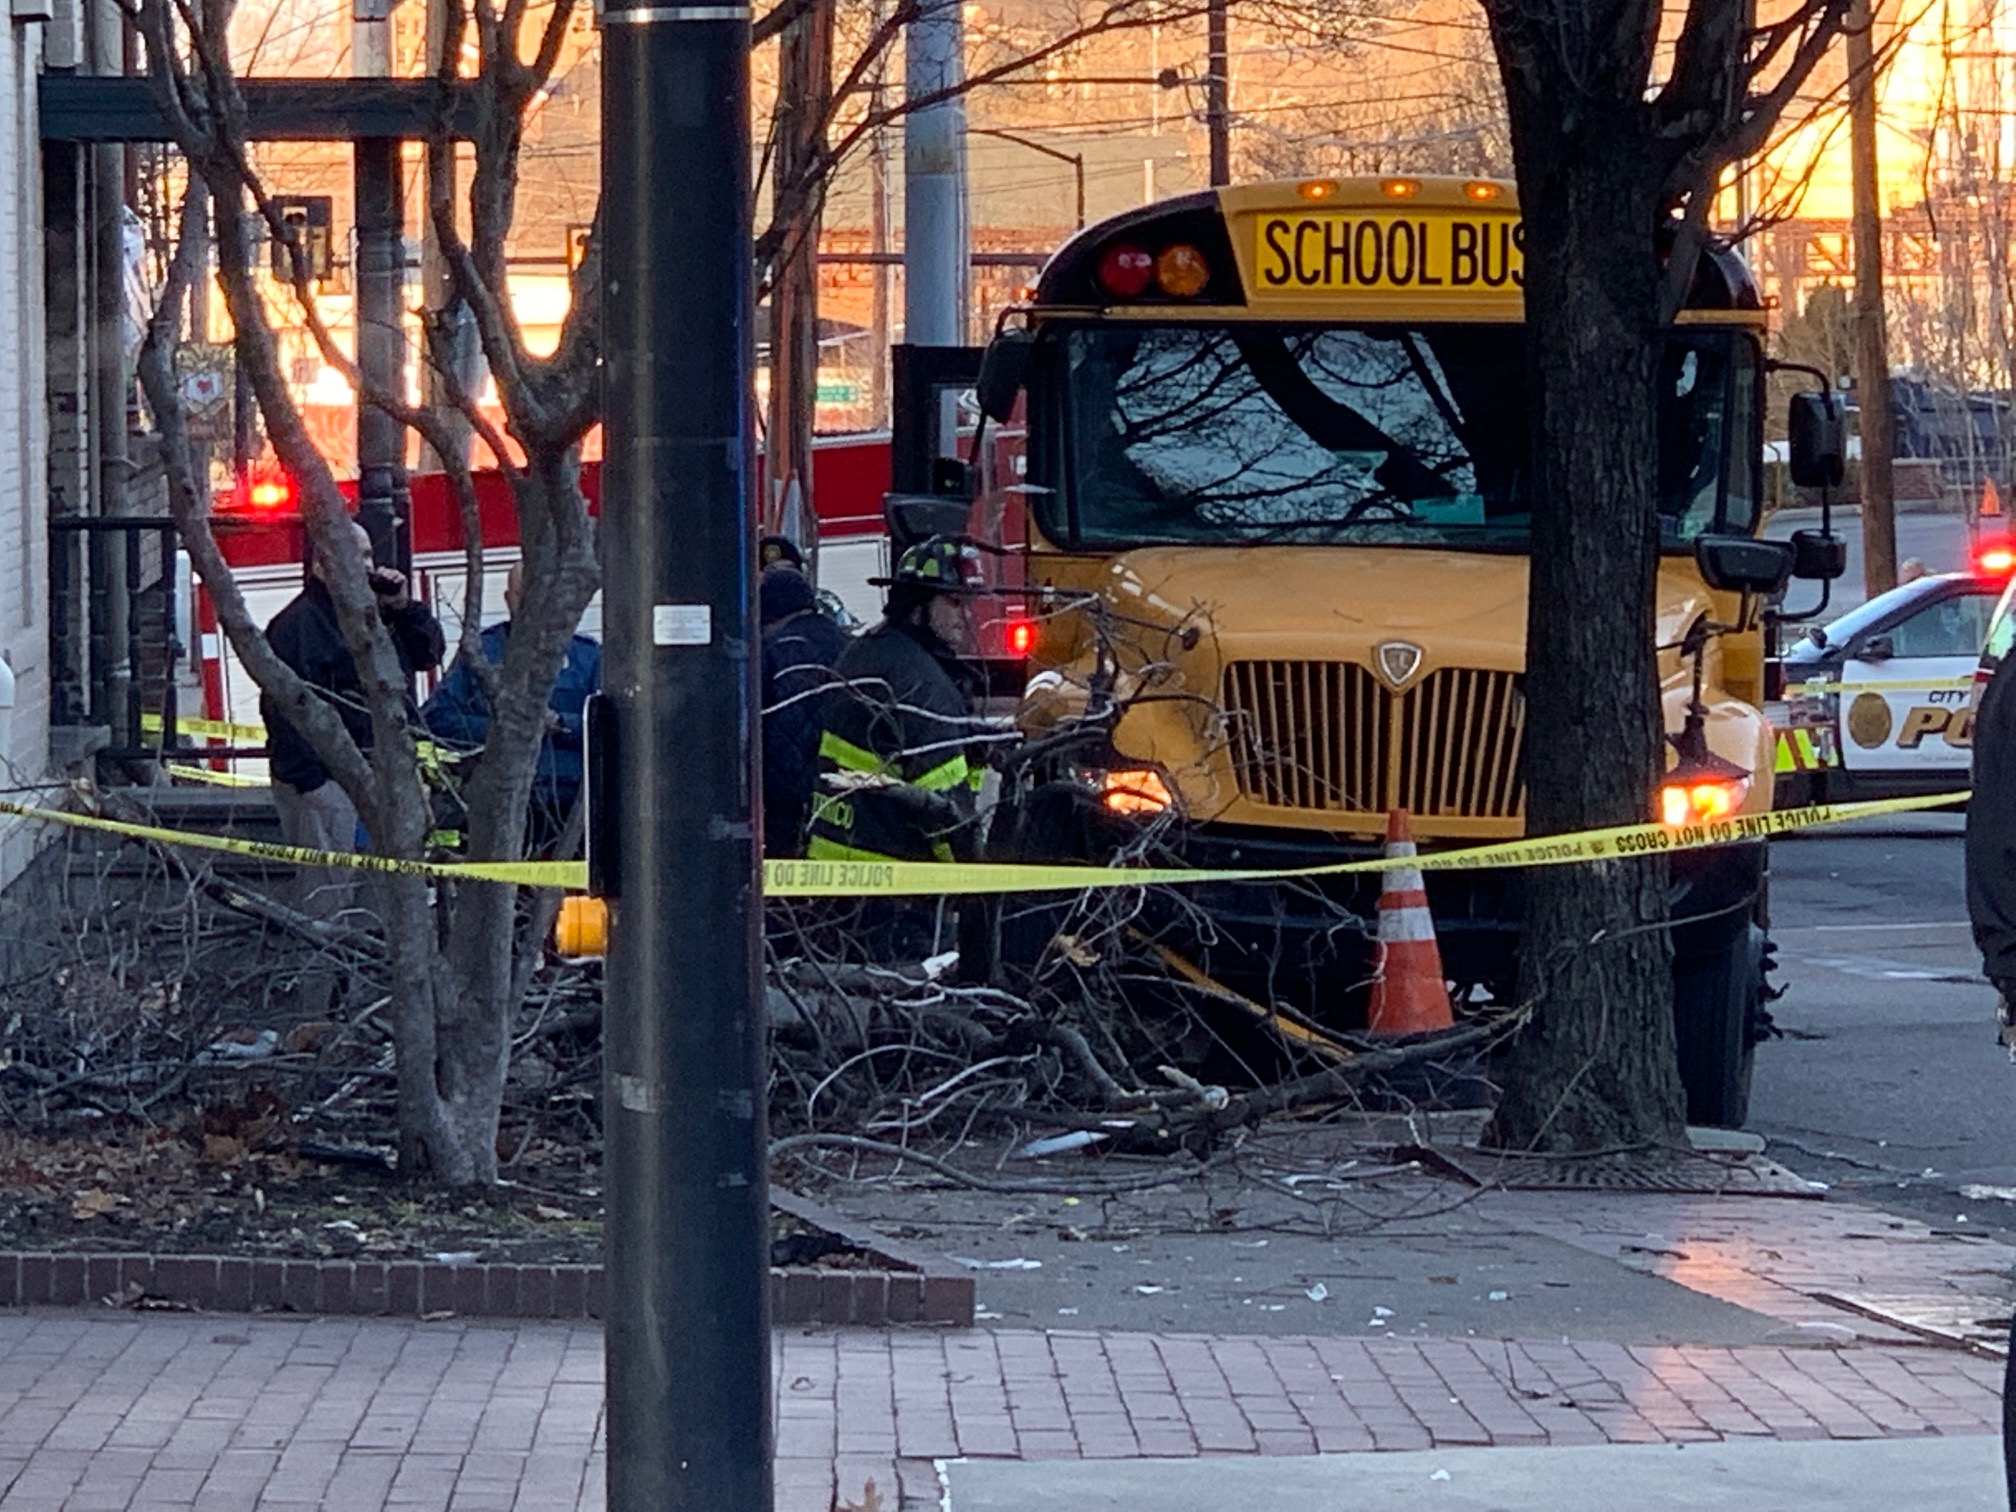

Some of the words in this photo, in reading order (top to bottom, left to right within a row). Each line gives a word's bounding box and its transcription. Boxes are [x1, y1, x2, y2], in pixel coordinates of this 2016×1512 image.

[1264, 219, 1443, 286] SCHOOL
[1928, 690, 1970, 704] CITY
[1674, 826, 1703, 847] NOT
[1710, 822, 1732, 843] DO
[1737, 815, 1771, 838] LINE
[1616, 829, 1669, 853] CROSS
